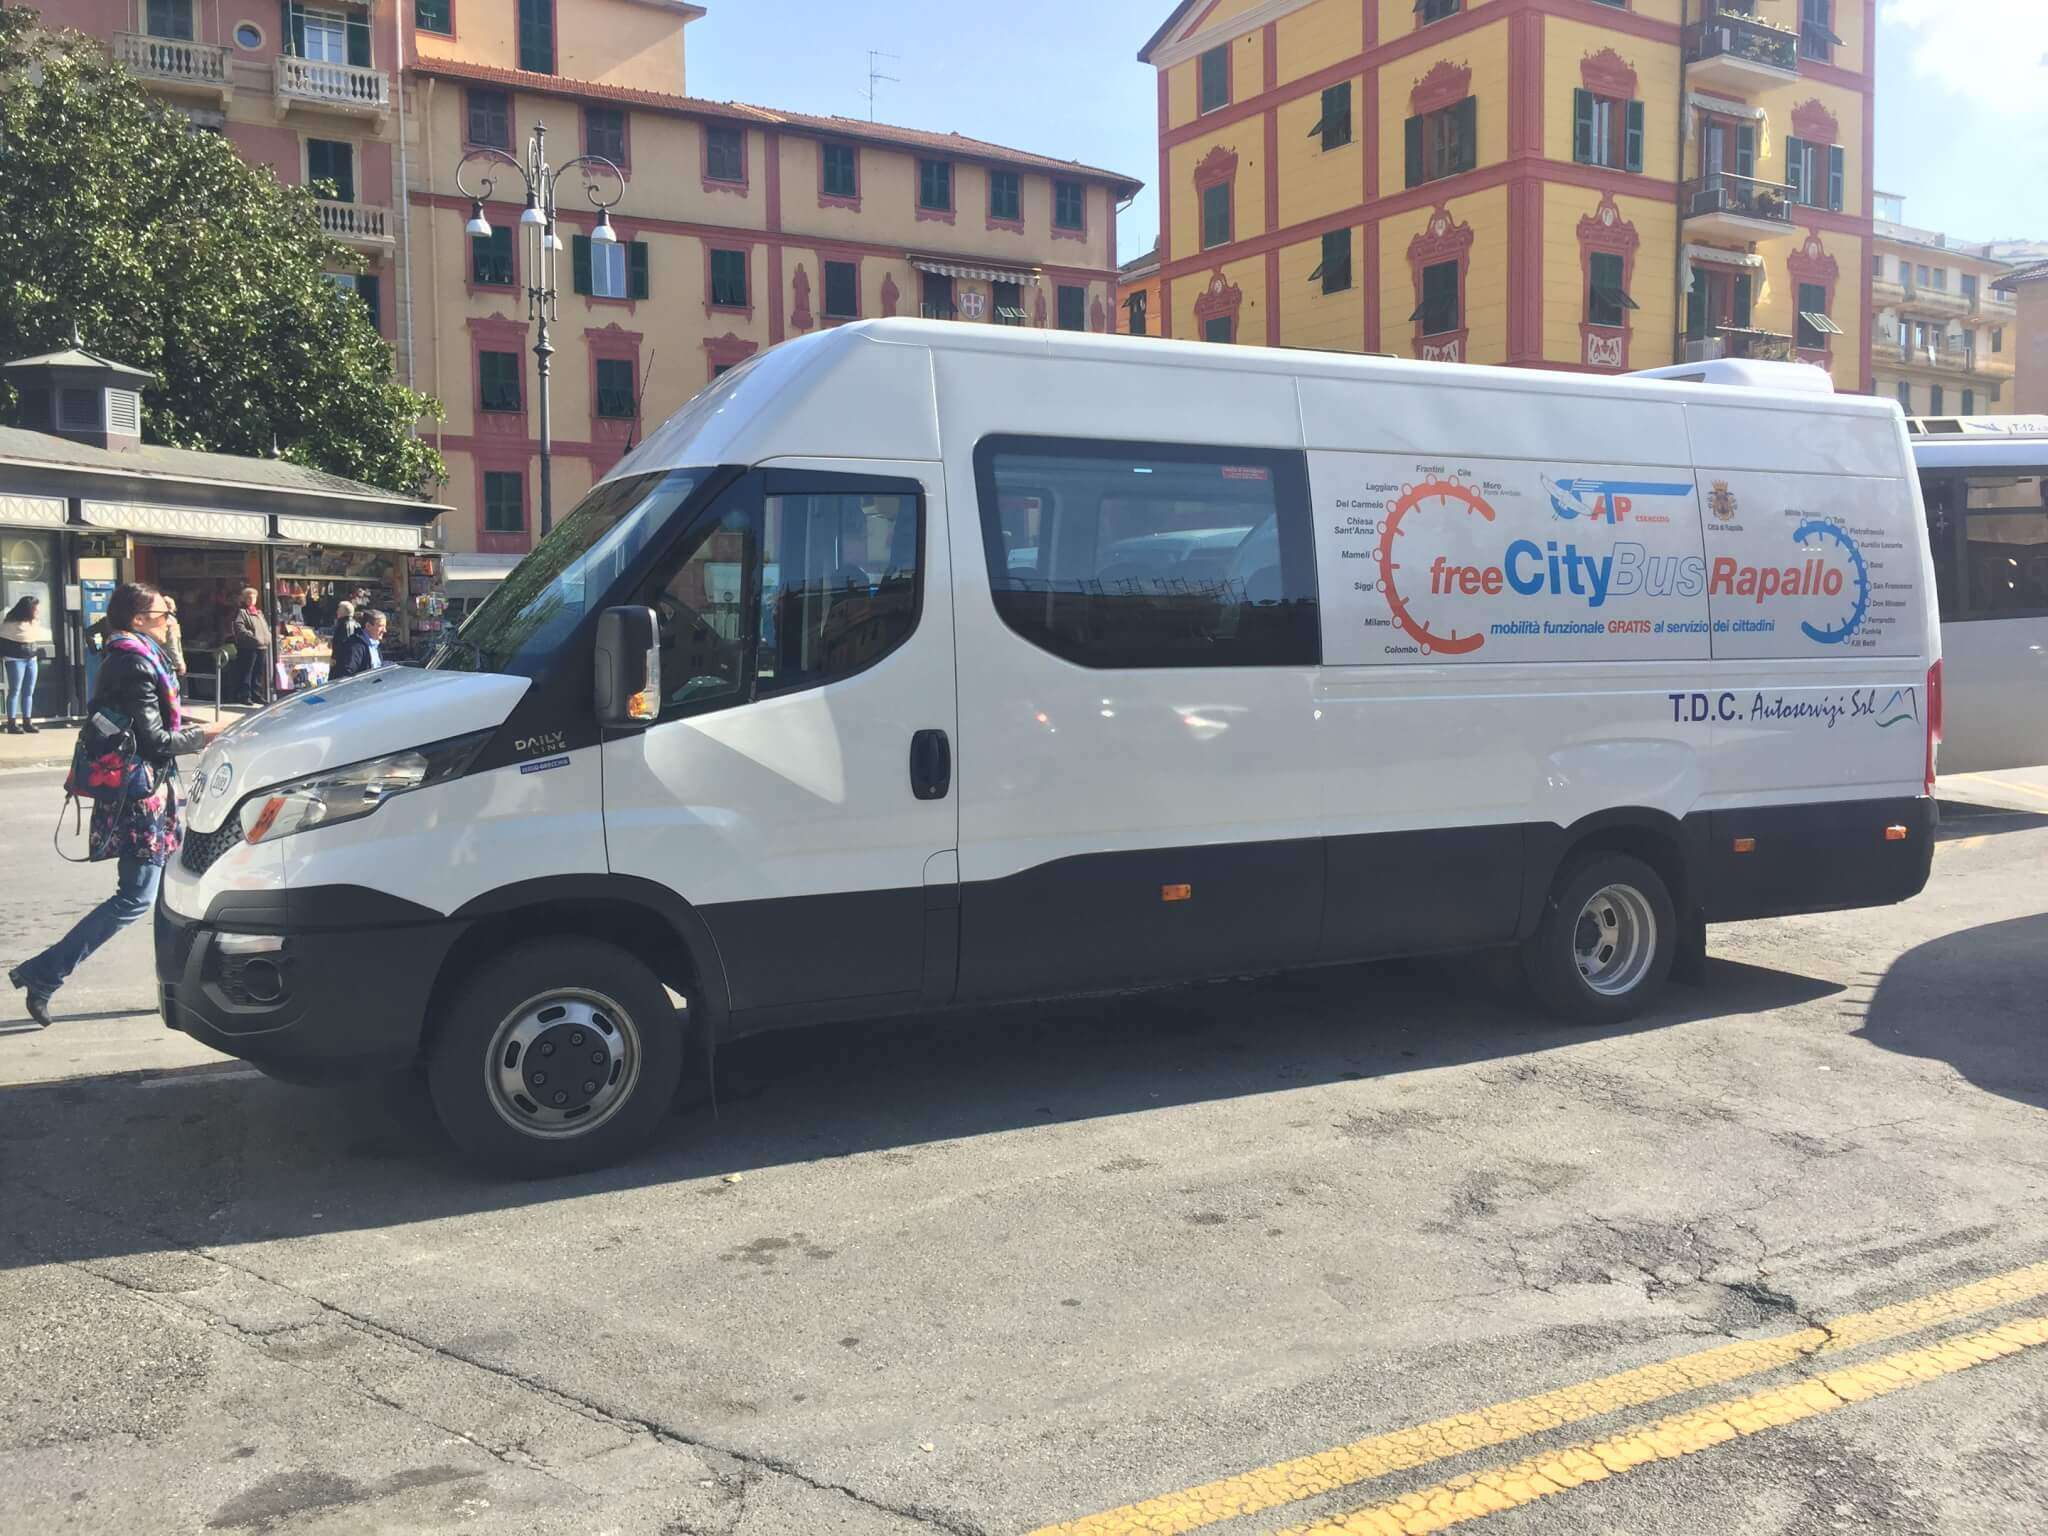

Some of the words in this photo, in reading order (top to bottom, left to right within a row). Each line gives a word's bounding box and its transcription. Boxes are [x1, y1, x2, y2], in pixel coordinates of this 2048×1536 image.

[1346, 516, 1374, 526] Chiesa
[1334, 526, 1375, 535] Sant'Anna
[1341, 550, 1371, 559] Mameli
[1709, 556, 1843, 605] Rapallo
[1364, 618, 1391, 627] Milano
[1490, 620, 1540, 635] mobilità
[1544, 620, 1605, 635] funzionale
[1608, 620, 1651, 634] GRATIS
[1654, 620, 1665, 633] al
[1667, 620, 1709, 633] servizio
[1713, 619, 1730, 633] dei
[1732, 619, 1776, 633] cittadini
[1384, 645, 1419, 654] Colombo
[1668, 692, 1743, 722] T.D.C.
[1750, 691, 1845, 729] Autoservizi
[1851, 689, 1876, 717] Srl
[515, 731, 563, 751] DAILY
